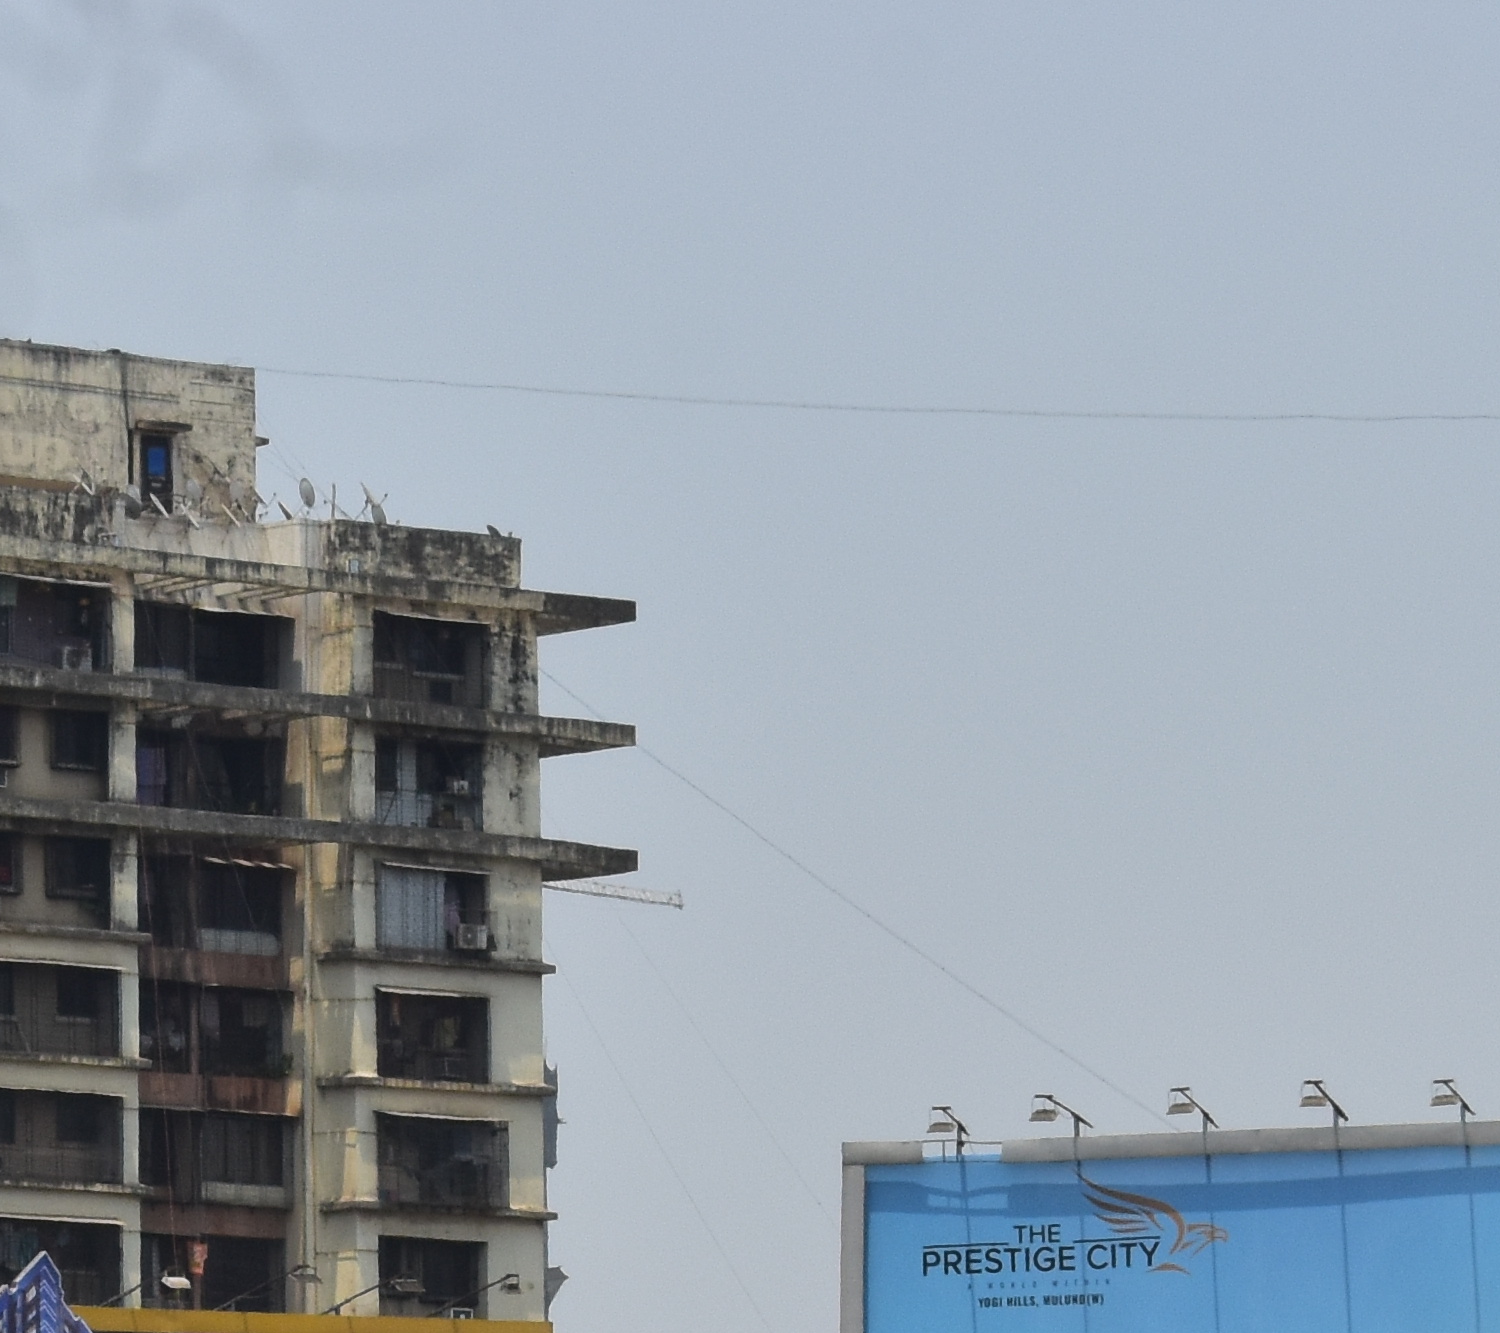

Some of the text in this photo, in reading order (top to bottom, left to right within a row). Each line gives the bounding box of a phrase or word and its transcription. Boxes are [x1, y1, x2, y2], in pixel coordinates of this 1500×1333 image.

[1013, 1224, 1061, 1245] THE
[922, 1241, 1161, 1277] PRESTIGE CITY
[978, 1297, 1003, 1308] YOGI
[1006, 1295, 1039, 1308] HILLS,
